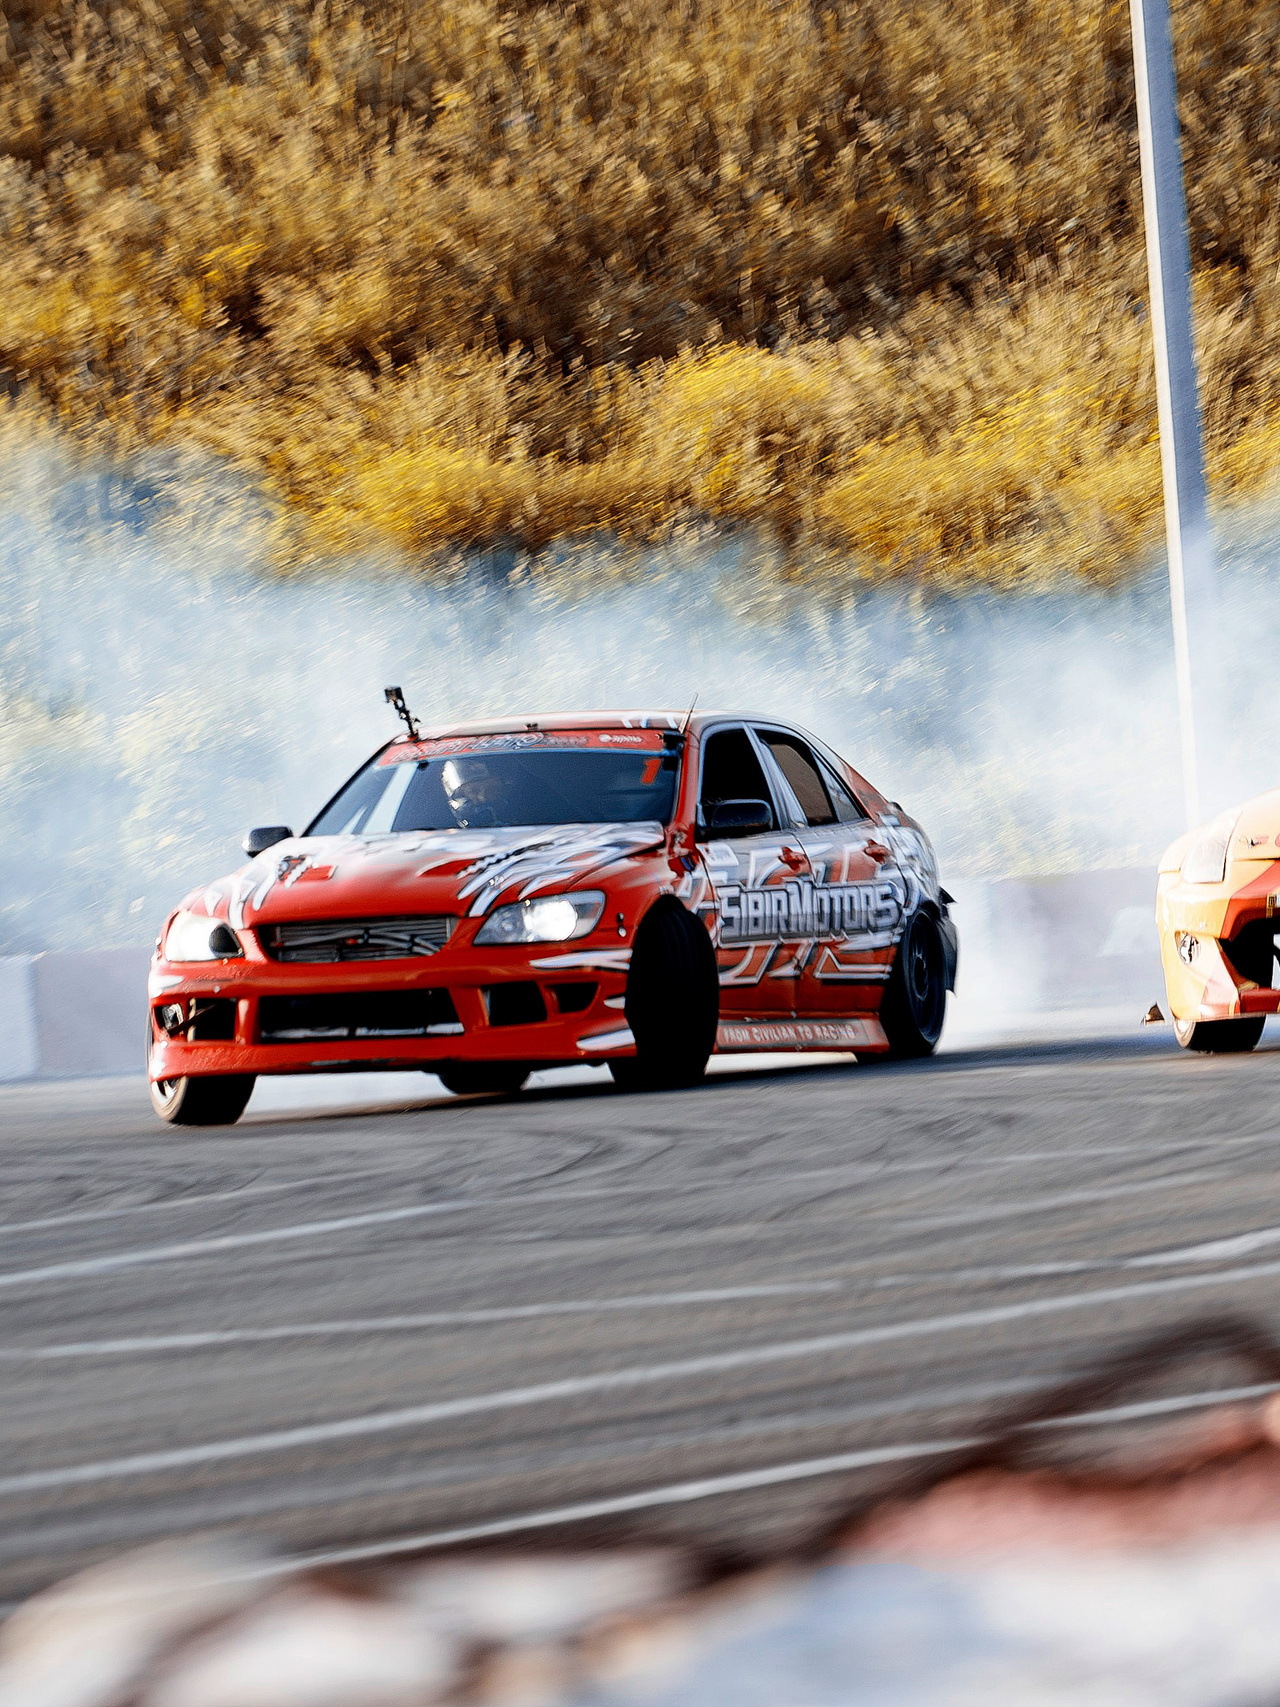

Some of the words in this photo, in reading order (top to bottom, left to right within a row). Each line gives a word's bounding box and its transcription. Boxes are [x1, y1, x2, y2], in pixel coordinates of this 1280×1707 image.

[641, 758, 662, 784] 1
[723, 1027, 750, 1043] FROM
[751, 1025, 796, 1042] CIVILIAN
[798, 1024, 814, 1040] TO
[815, 1022, 857, 1040] RACING
